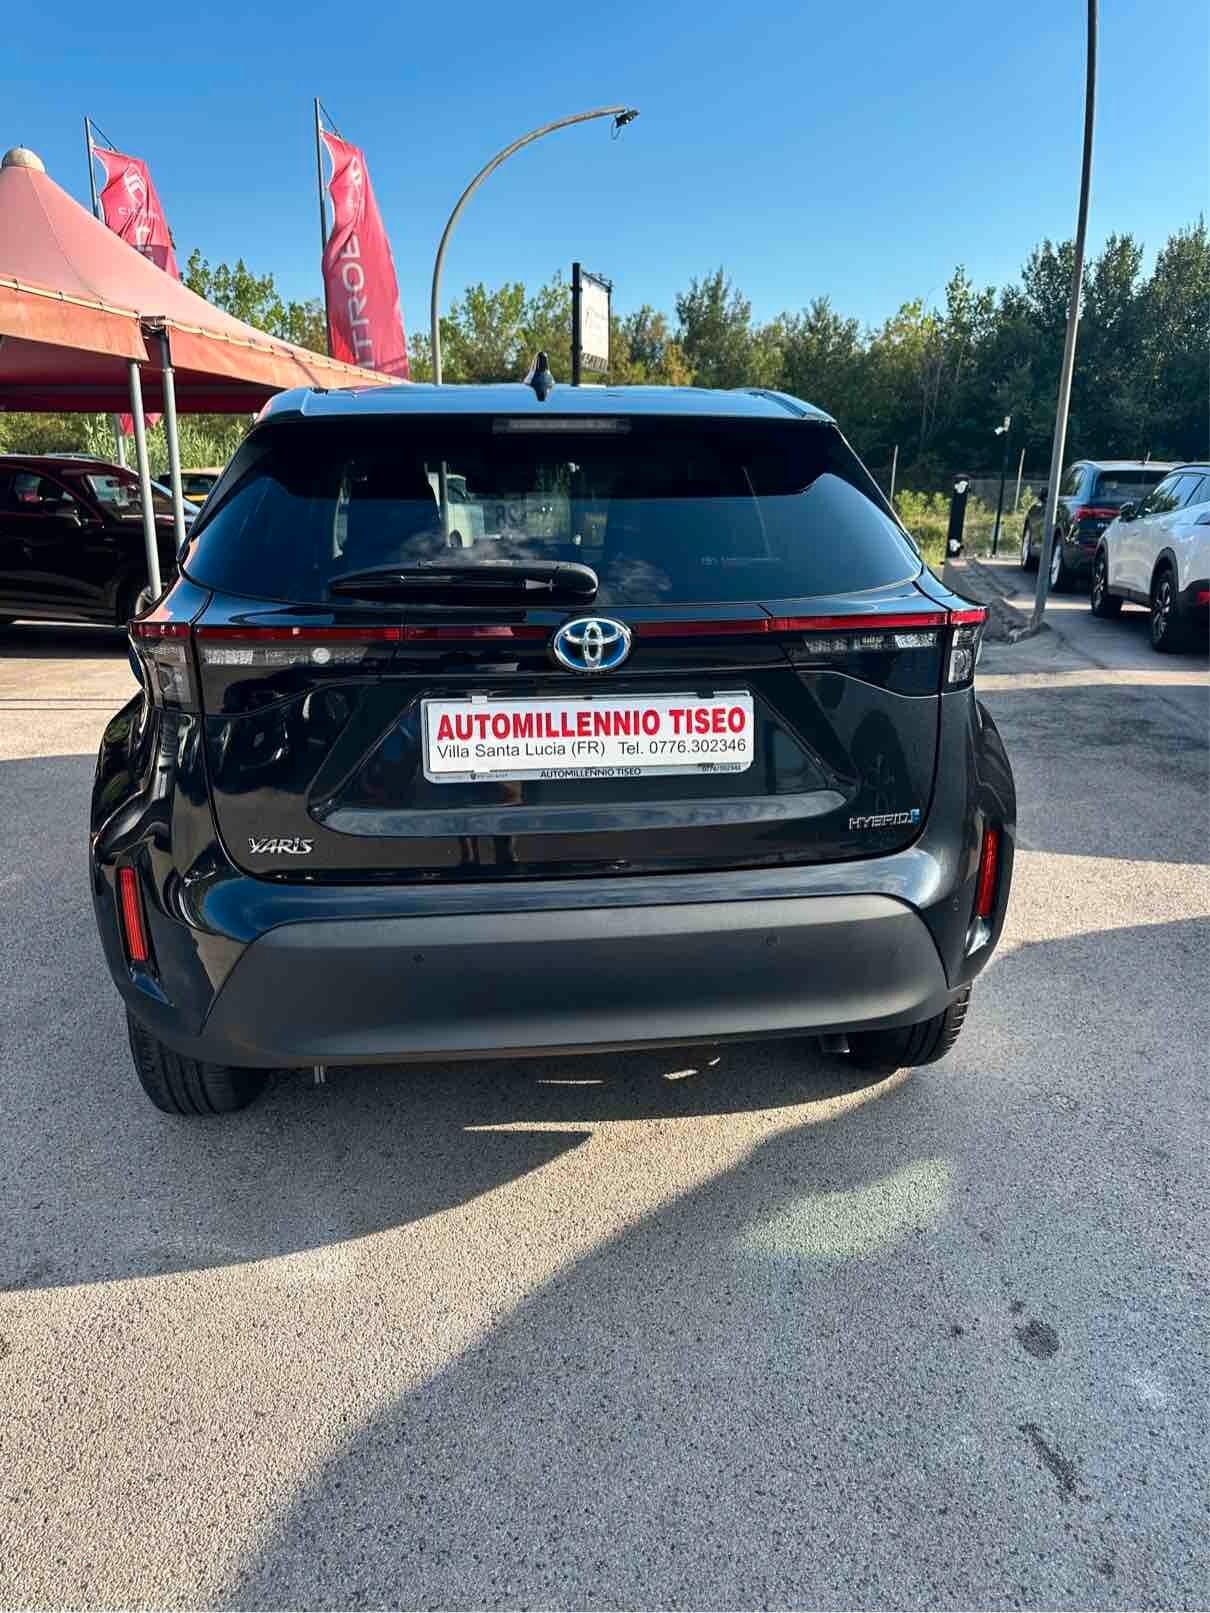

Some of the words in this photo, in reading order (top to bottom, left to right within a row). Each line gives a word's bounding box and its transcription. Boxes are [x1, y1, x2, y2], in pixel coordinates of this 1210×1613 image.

[437, 709, 660, 740] AUTOMILLENNIO
[669, 706, 746, 735] TISEO
[437, 743, 469, 759] Villa
[475, 742, 520, 758] Santa
[526, 742, 566, 757] Lucia
[571, 740, 605, 758] (FR)
[618, 741, 644, 755] Tel.
[649, 738, 746, 755] 0776.302346
[540, 767, 613, 778] AUTOMILLENNIO
[616, 767, 641, 777] TISEO
[849, 812, 912, 830] HYBRID
[248, 837, 313, 854] YARIS
